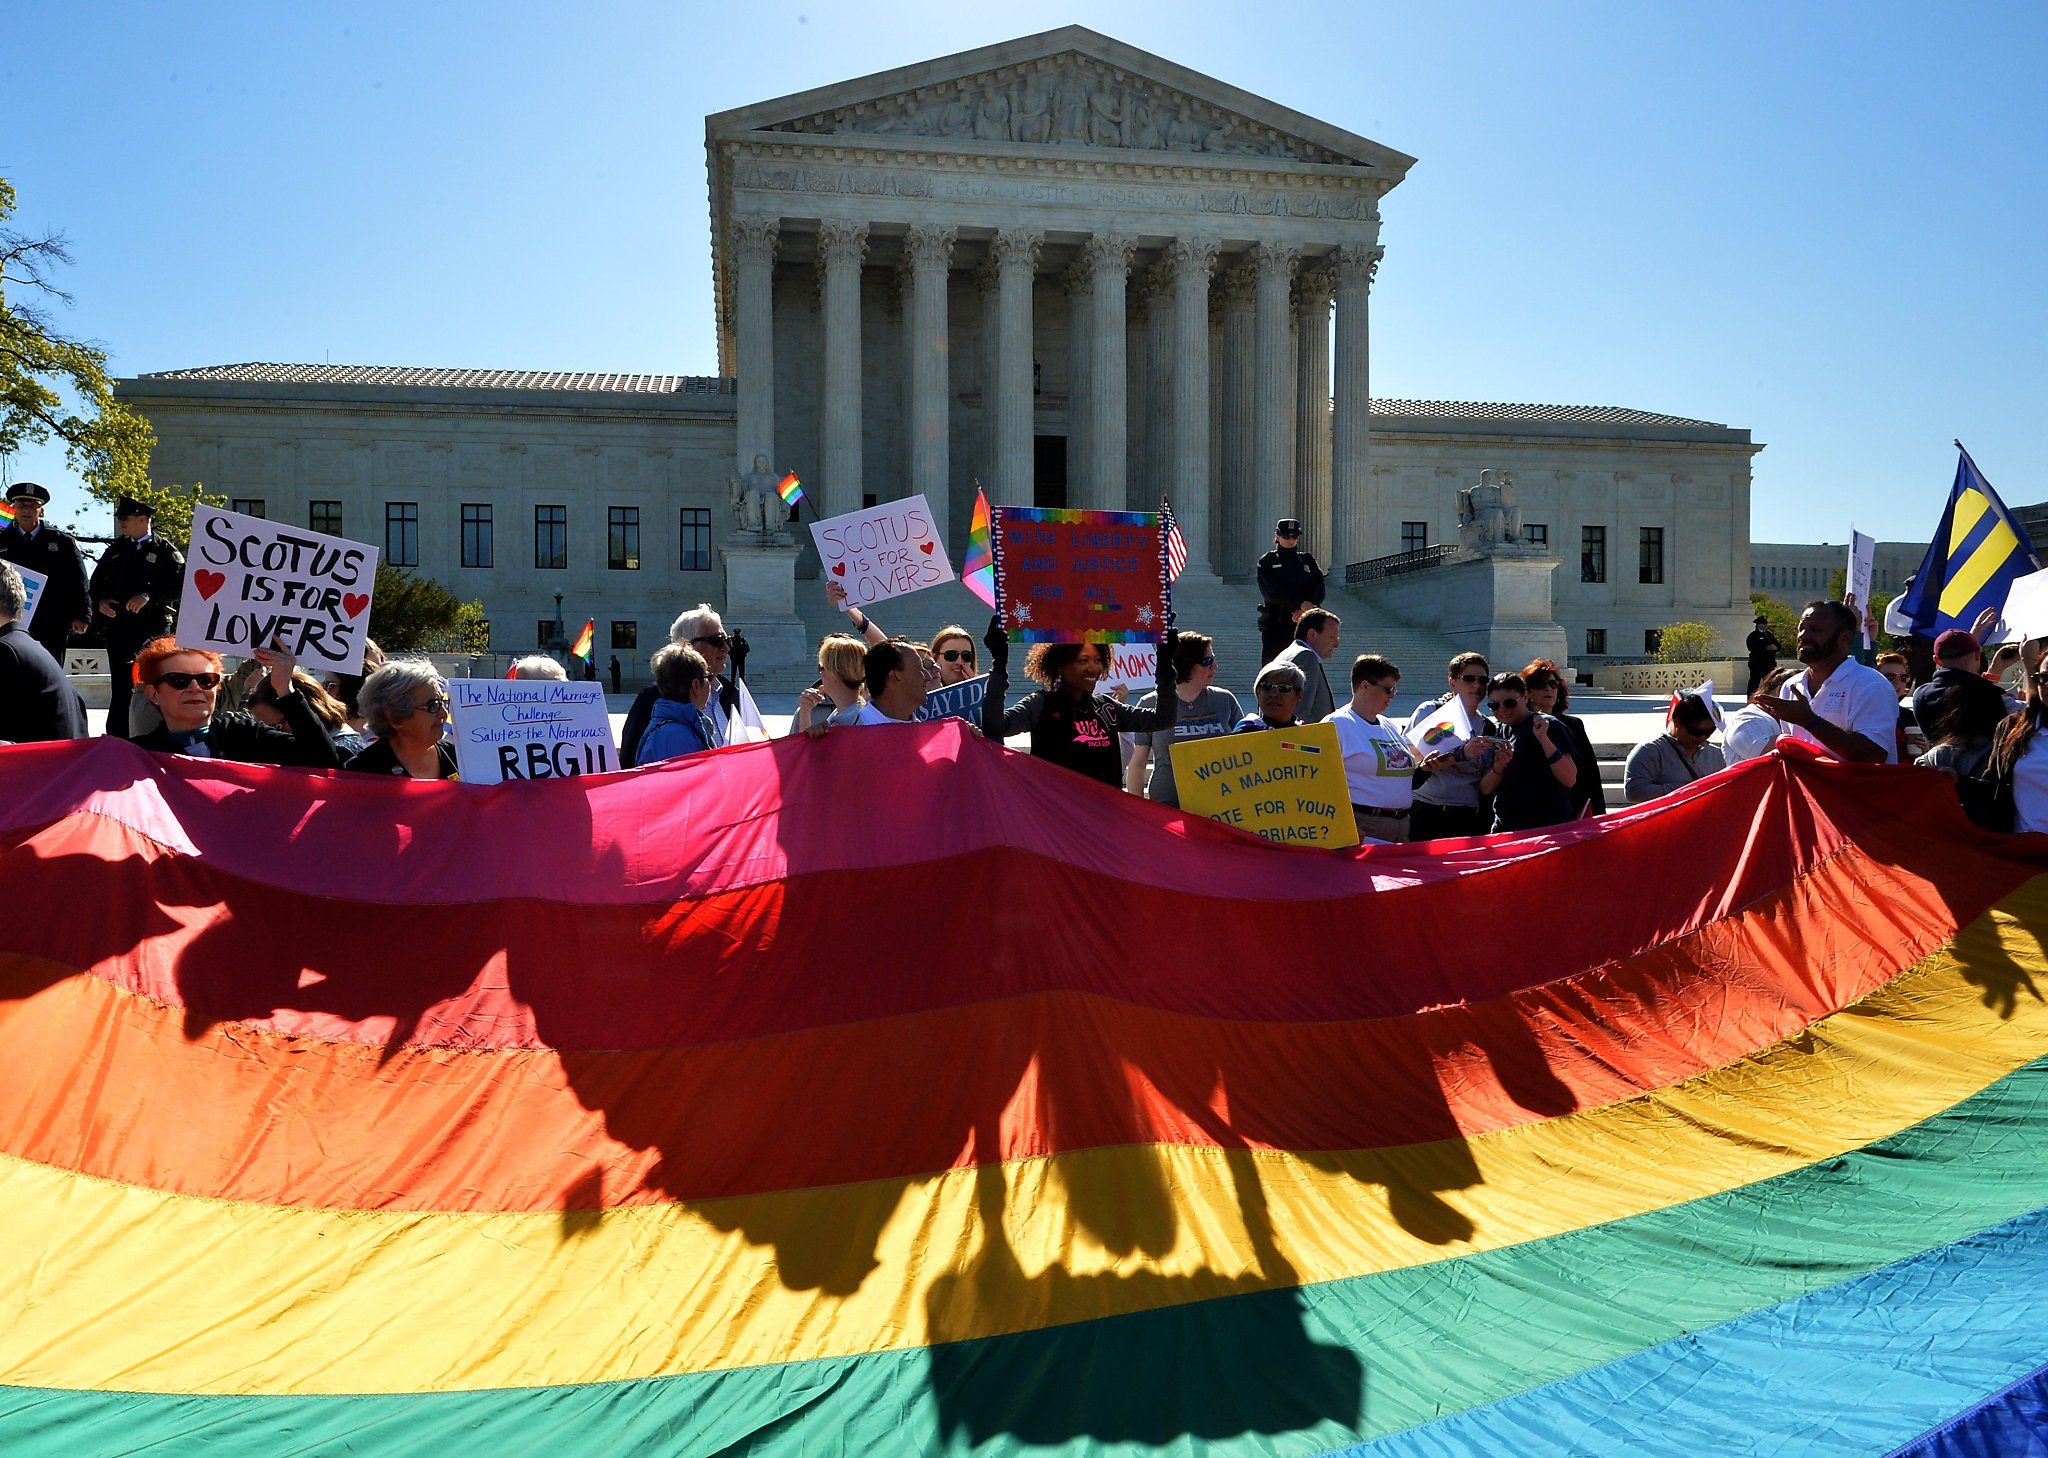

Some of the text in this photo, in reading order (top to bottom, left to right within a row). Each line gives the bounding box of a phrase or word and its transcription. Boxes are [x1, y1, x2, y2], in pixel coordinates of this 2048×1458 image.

[945, 180, 1189, 207] EQUAL JUSTICE UNDER LAW
[822, 510, 929, 559] SCOTUS
[1009, 530, 1148, 548] WITH LIBERTY
[200, 516, 365, 586] SCOTUS
[853, 548, 914, 573] IS FOR
[1022, 557, 1139, 572] AND JUSTICE
[840, 560, 941, 607] LOVERS
[1032, 584, 1118, 600] FOR ALL
[241, 573, 342, 623] IS FOR
[205, 602, 355, 661] LOVERS
[1112, 652, 1156, 680] MOMS
[452, 684, 601, 705] The National Marriage
[919, 690, 953, 722] SAY
[502, 704, 564, 724] Challenge
[471, 724, 607, 743] Salutes the Notorious
[1194, 752, 1253, 781] WOULD
[1221, 764, 1319, 796] A MAJORITY
[1209, 798, 1336, 825] OTE FOR YOUR
[1252, 825, 1329, 841] RRIAGE?
